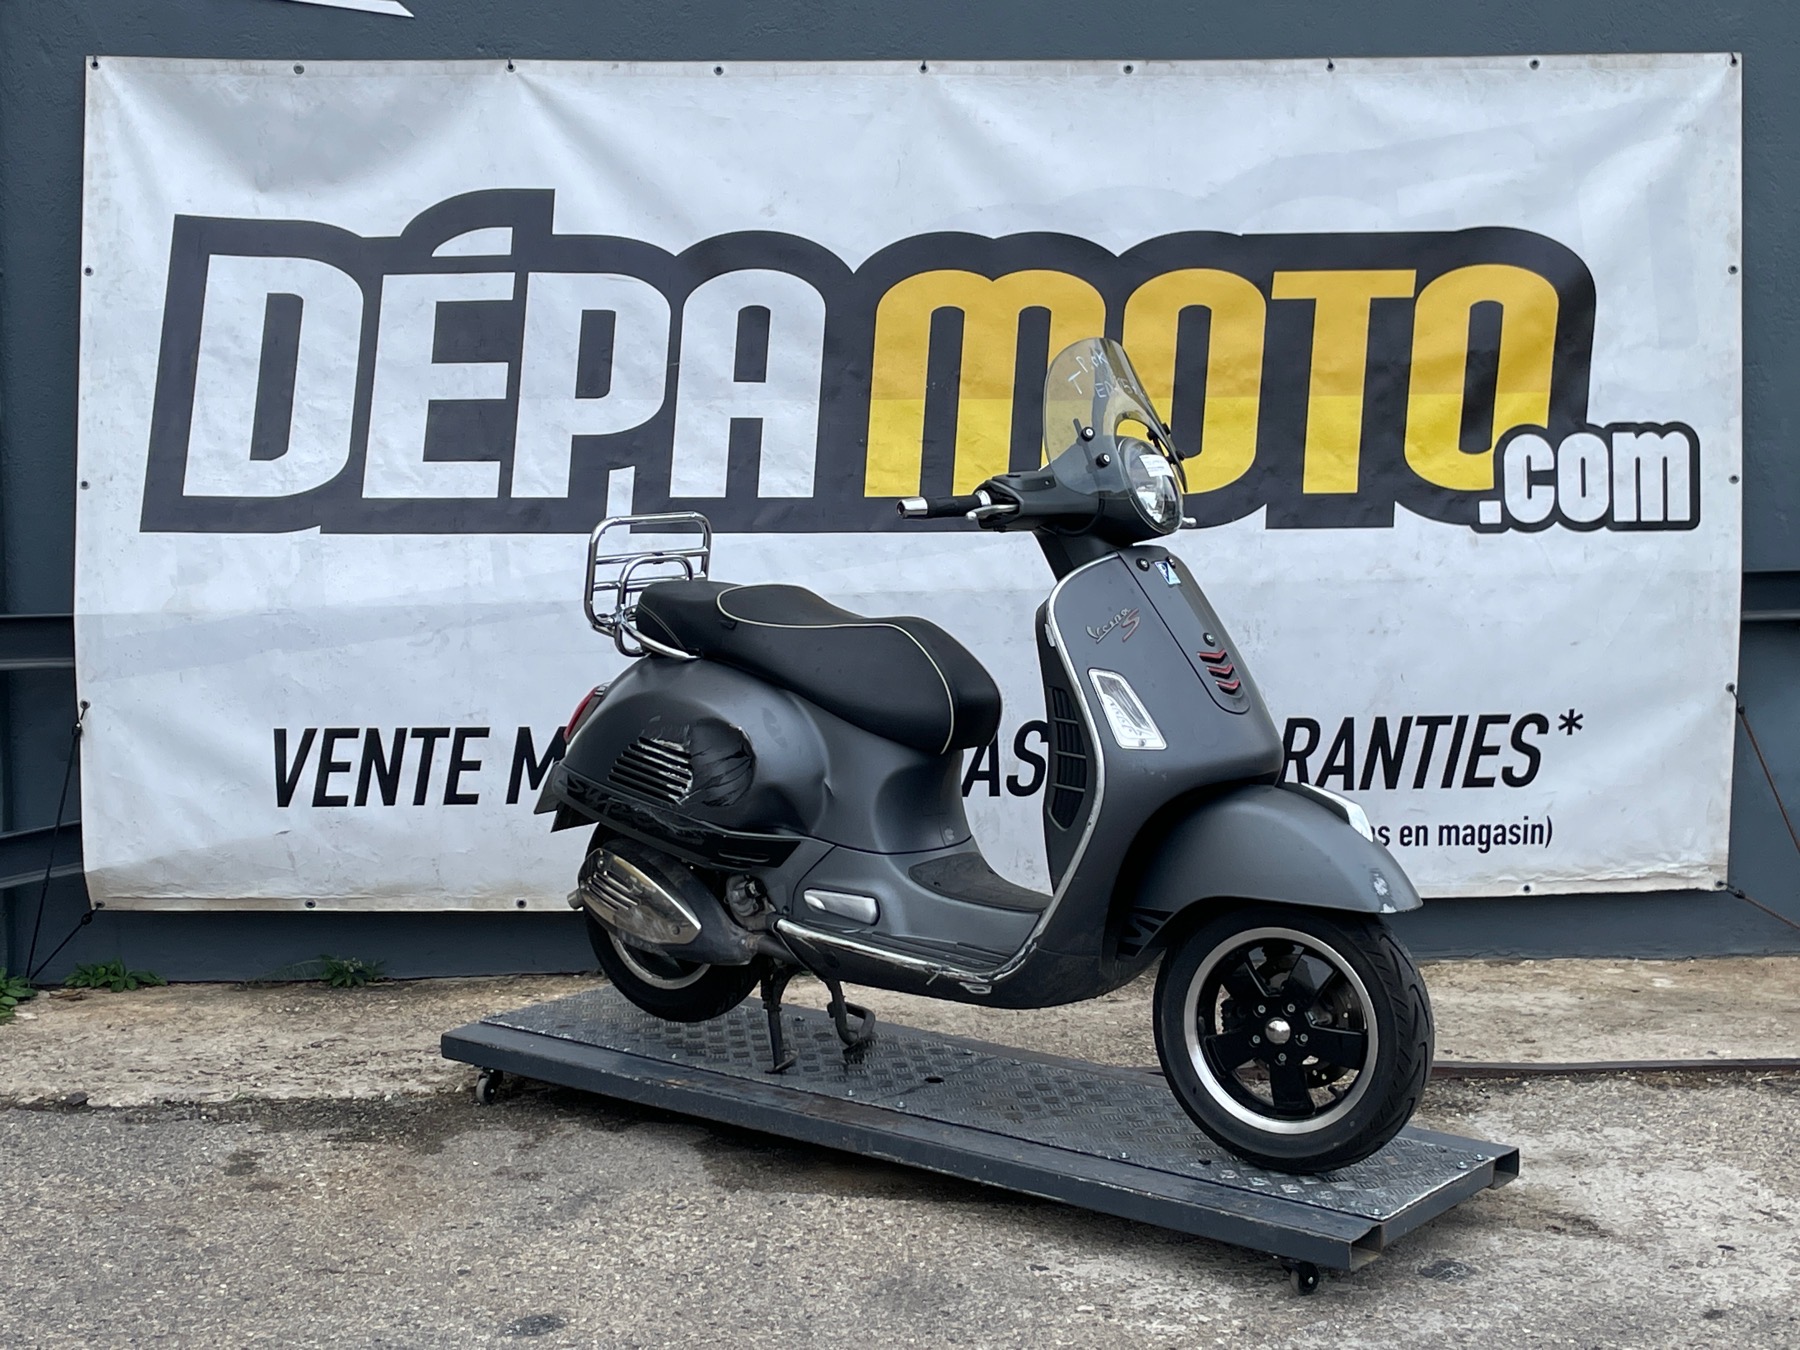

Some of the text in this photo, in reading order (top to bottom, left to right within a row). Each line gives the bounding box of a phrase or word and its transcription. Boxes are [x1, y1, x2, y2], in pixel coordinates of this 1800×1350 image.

[273, 727, 490, 808] VENTE
[1276, 709, 1584, 791] RANTIES
[1400, 824, 1429, 847] en
[1438, 815, 1553, 854] magasin)
